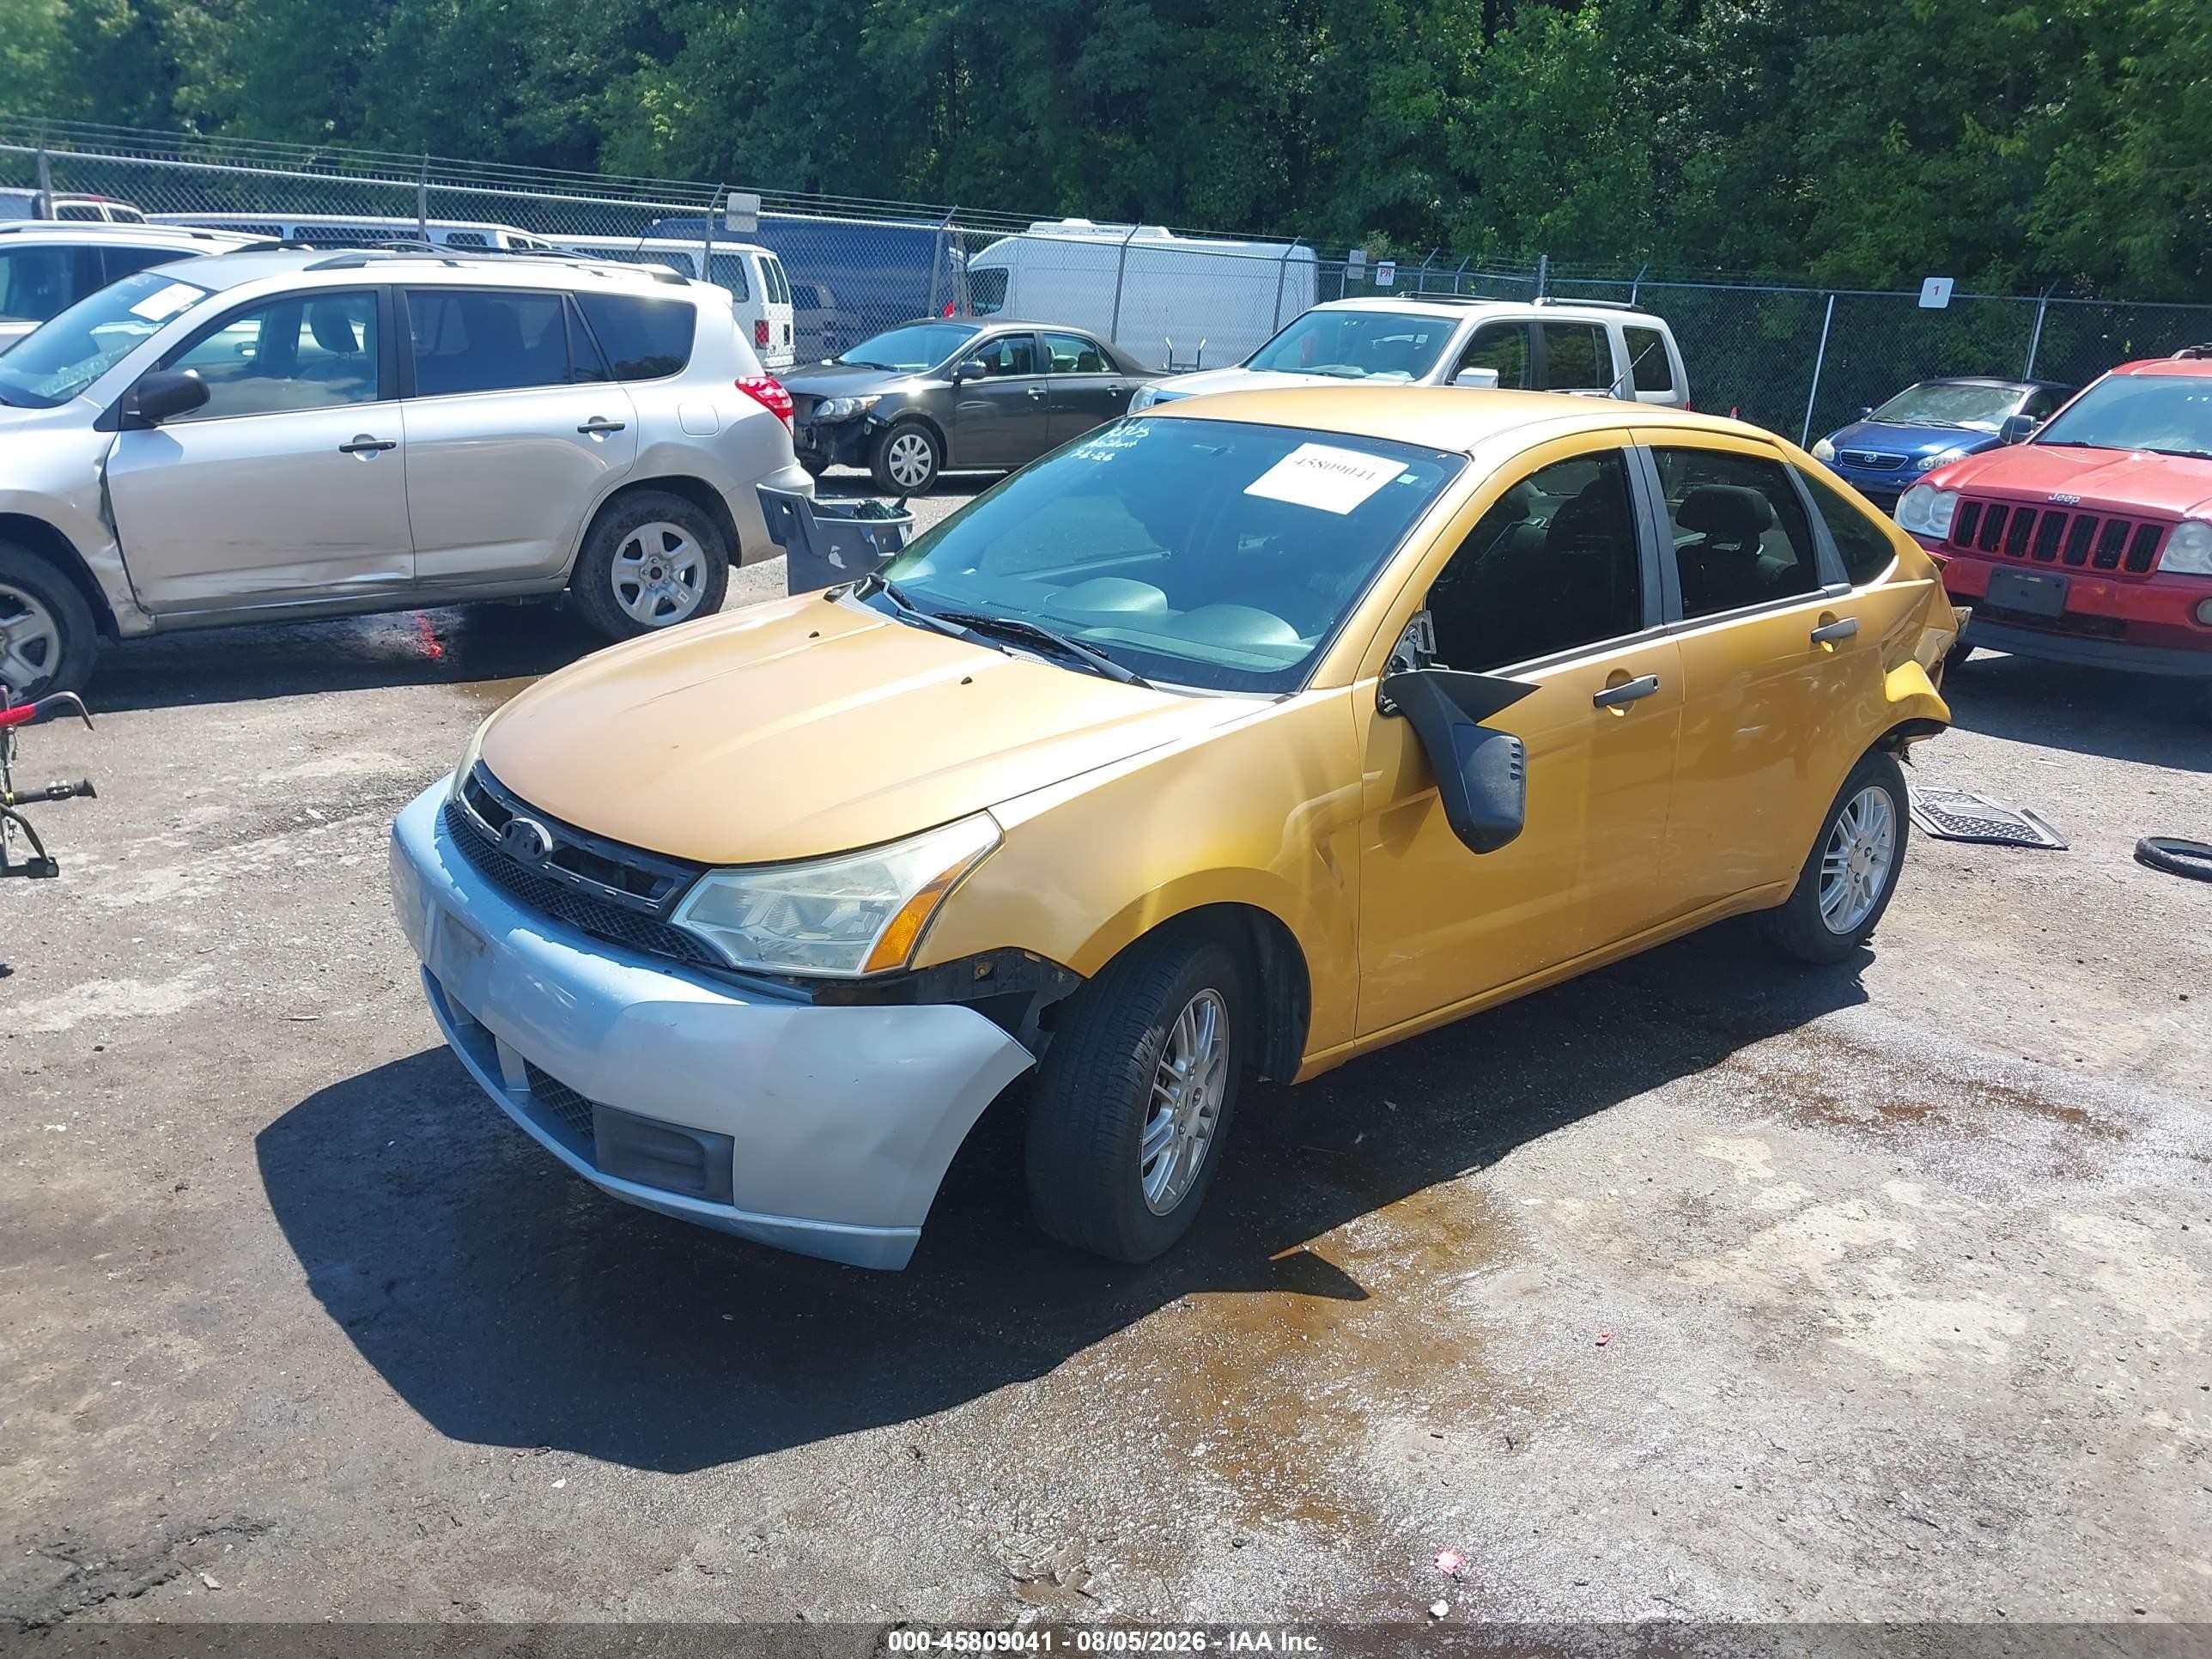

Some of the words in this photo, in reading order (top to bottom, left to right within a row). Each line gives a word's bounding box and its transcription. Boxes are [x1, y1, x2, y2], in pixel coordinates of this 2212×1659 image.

[1933, 285, 1941, 296] 1
[1293, 457, 1376, 481] 45809041
[2047, 493, 2081, 505] Jeep
